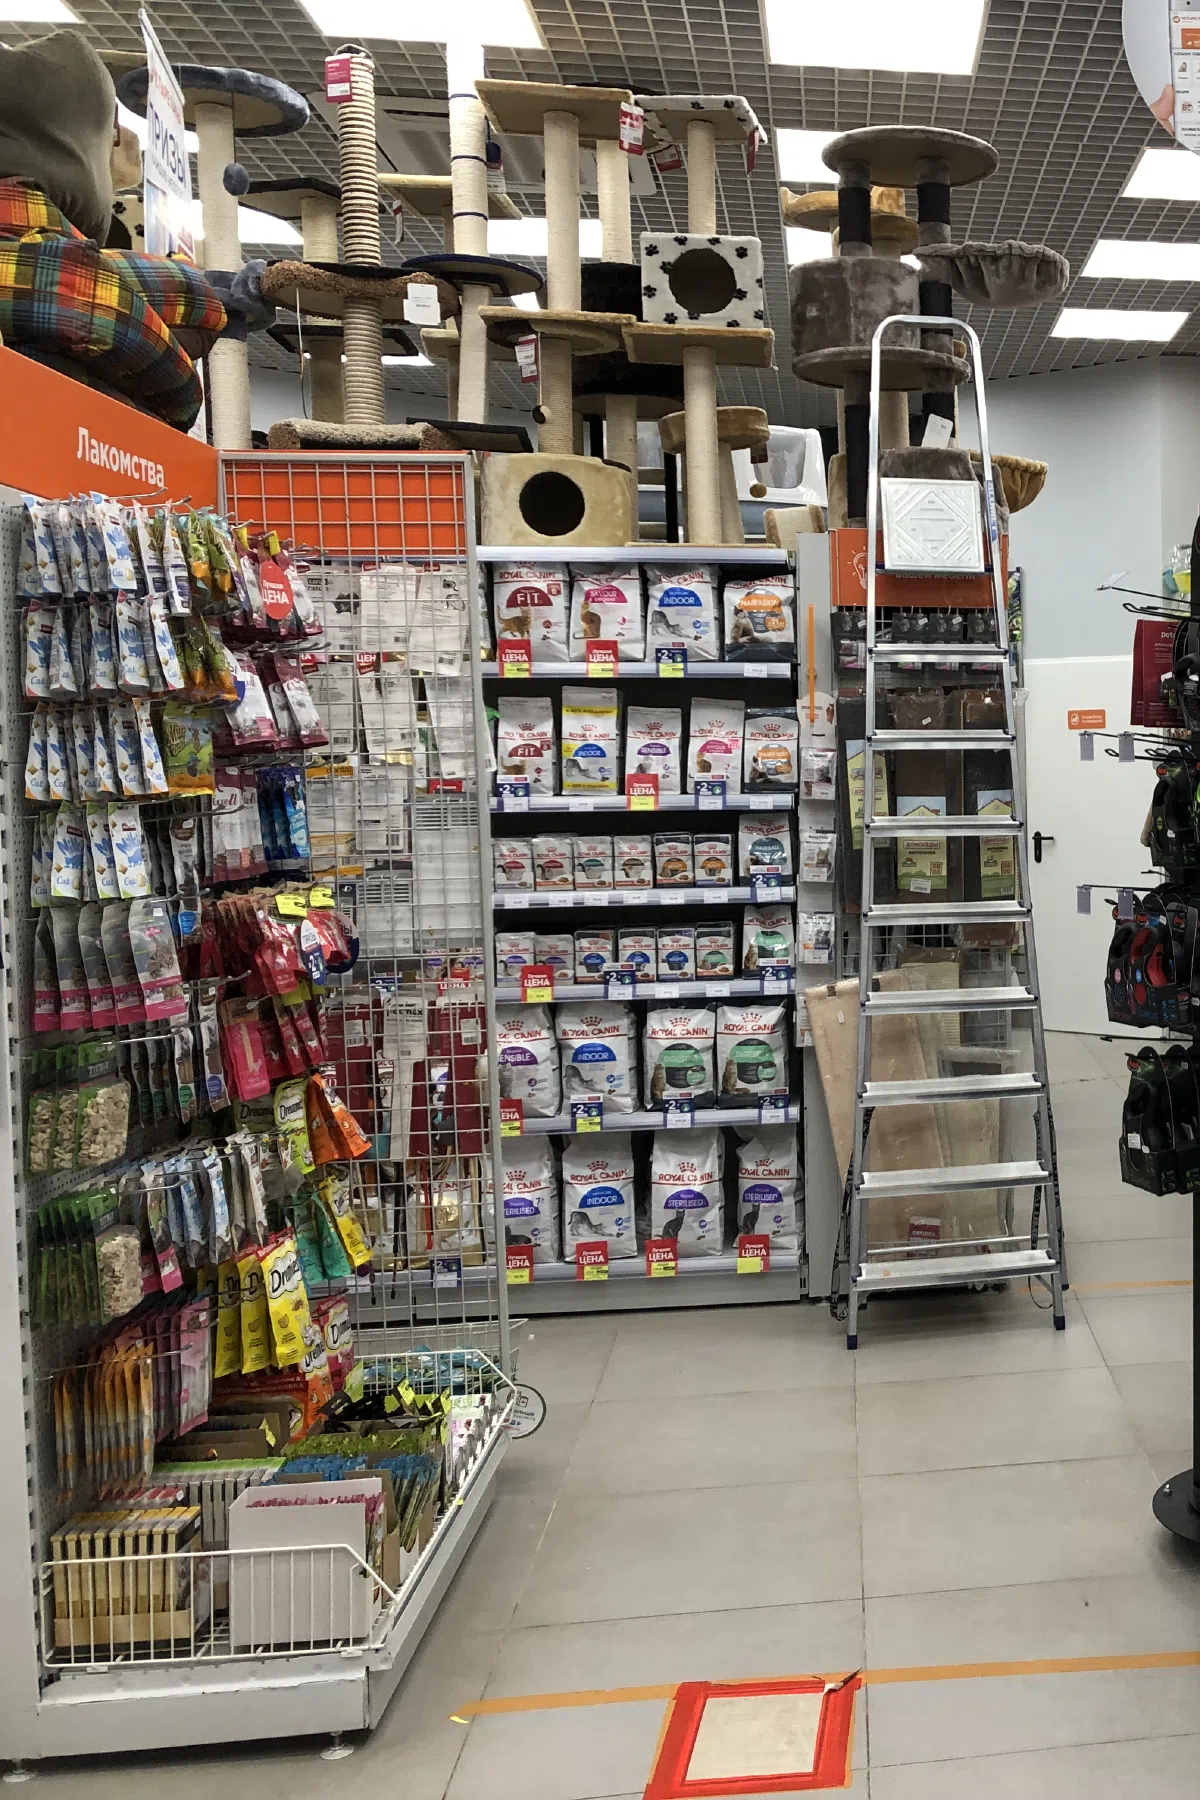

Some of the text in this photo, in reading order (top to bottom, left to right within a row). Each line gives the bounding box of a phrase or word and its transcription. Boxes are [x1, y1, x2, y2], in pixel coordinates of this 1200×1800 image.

[77, 426, 165, 488] Лакомства
[112, 568, 124, 578] Cat
[499, 571, 556, 579] ROYAL CANIN
[262, 589, 289, 605] ЦЕНА
[516, 592, 540, 605] FIT
[663, 596, 695, 605] INDOOR
[502, 653, 528, 662] ЦЕНА
[589, 653, 616, 662] ЦЕНА
[517, 747, 535, 756] FIT
[629, 787, 656, 797] ЦЕНА
[57, 876, 70, 885] Cat
[524, 979, 551, 987] ЦЕНА
[592, 1025, 620, 1035] CANIN
[724, 1023, 748, 1031] ROYAL
[513, 1029, 542, 1039] CANIN
[651, 1028, 708, 1036] ROYAL CANIN
[499, 1054, 531, 1062] ENSIBLE
[578, 1052, 609, 1060] INDOOR
[501, 1112, 520, 1120] ЕНА
[571, 1171, 598, 1182] ROYAL
[762, 1168, 790, 1176] CANIN
[659, 1174, 685, 1182] ROYAL
[587, 1196, 618, 1205] INDOOR
[745, 1193, 778, 1201] STERILISED
[668, 1199, 704, 1207] STERILISED
[504, 1206, 535, 1216] TERILISED
[649, 1253, 674, 1262] ЦЕНА
[742, 1249, 766, 1257] ЦЕНА
[579, 1255, 605, 1264] ЦЕНА
[506, 1260, 530, 1269] ЦЕНА
